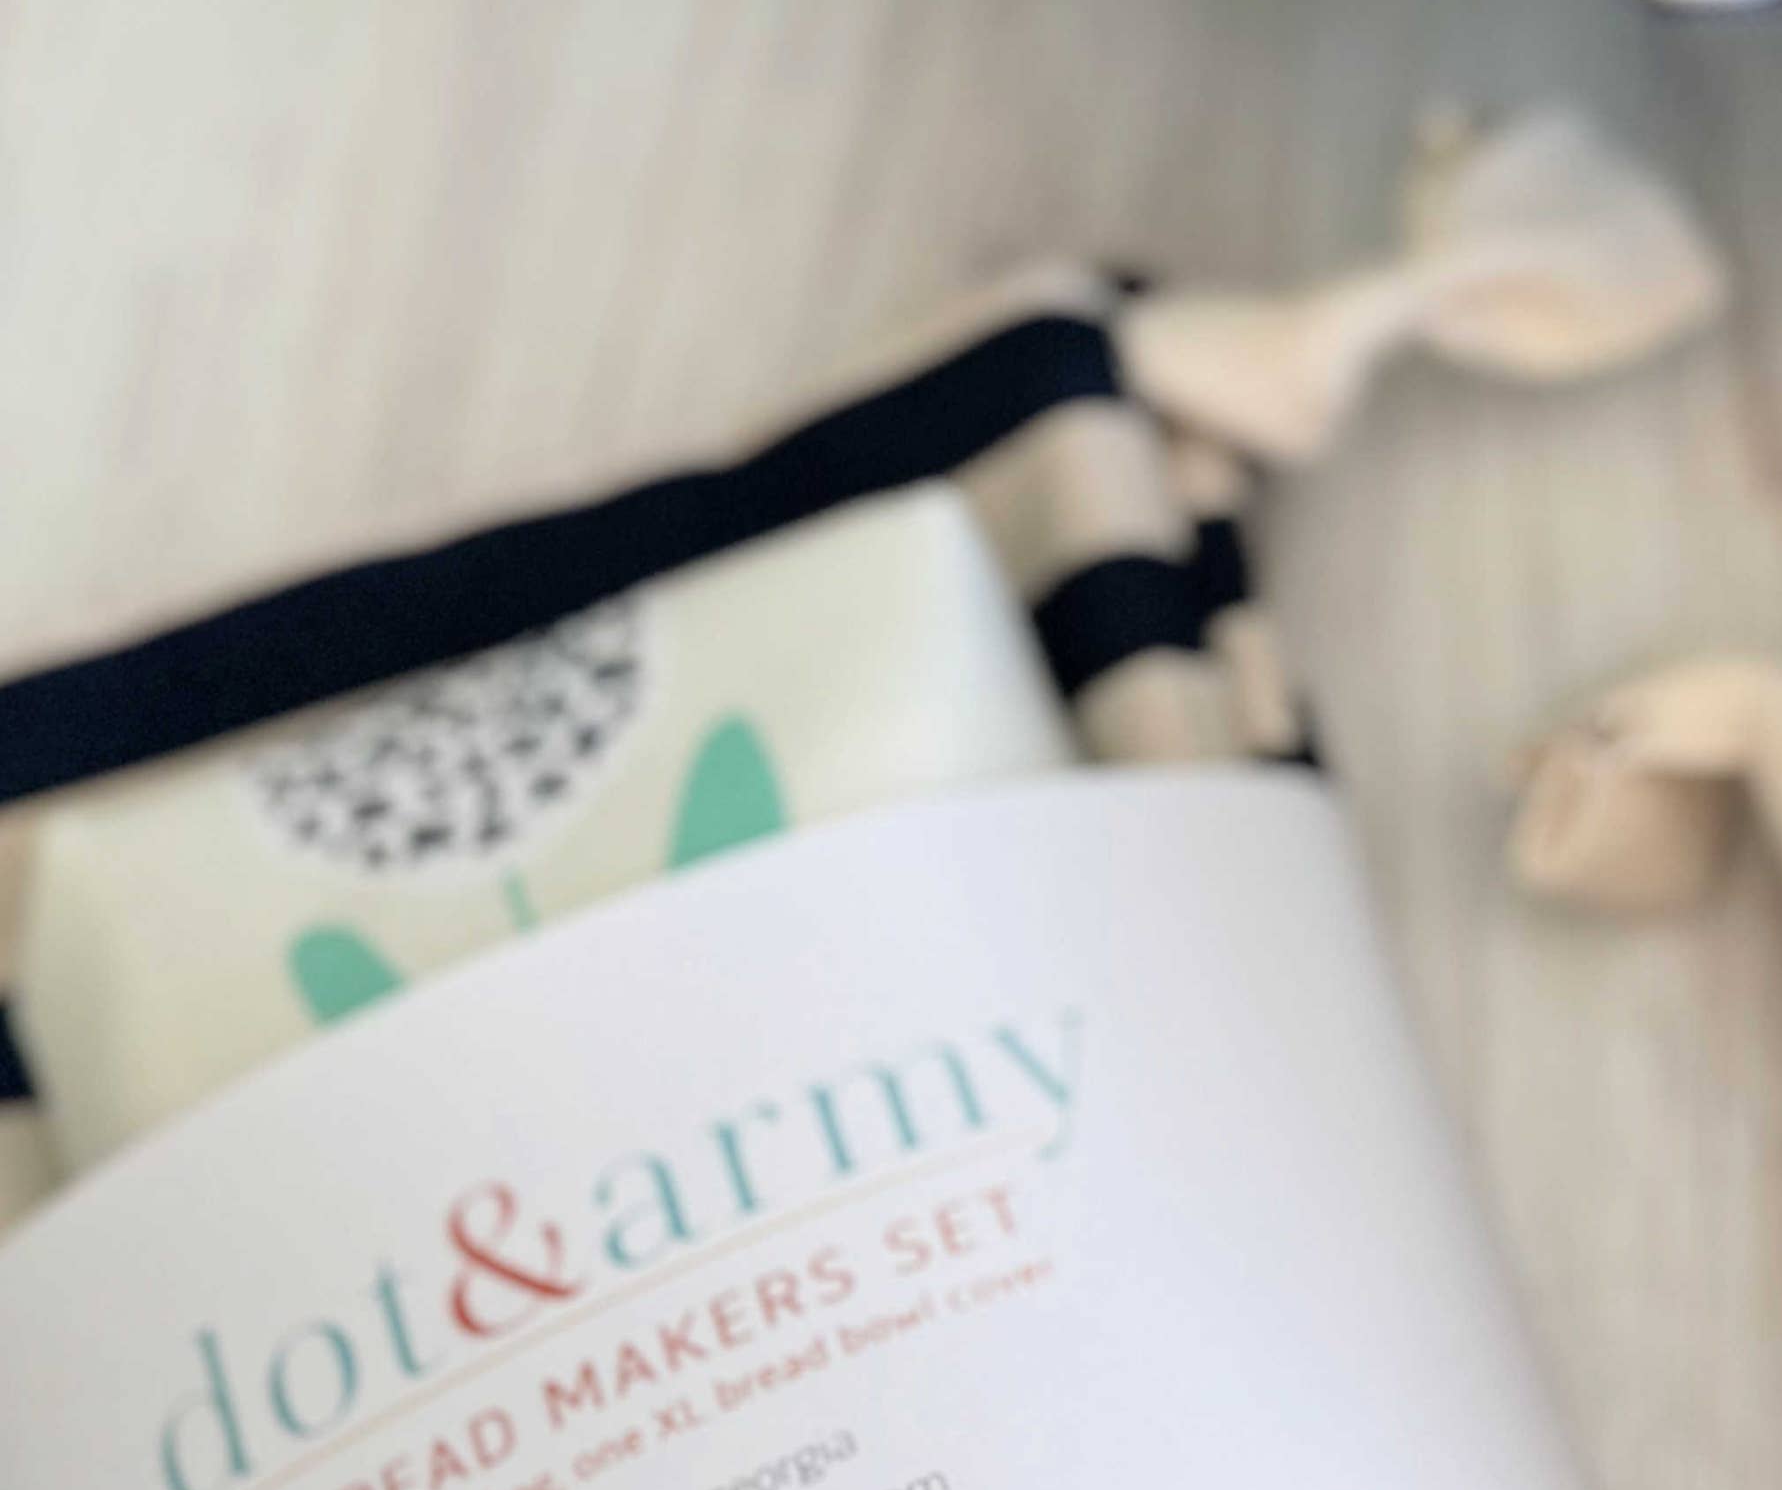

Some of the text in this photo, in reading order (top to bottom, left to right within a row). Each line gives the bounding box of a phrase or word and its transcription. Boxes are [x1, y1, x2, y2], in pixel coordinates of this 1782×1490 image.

[541, 1245, 857, 1432] MAKERS
[882, 1185, 1021, 1277] SET
[571, 1428, 644, 1482] one
[713, 1334, 831, 1412] bread
